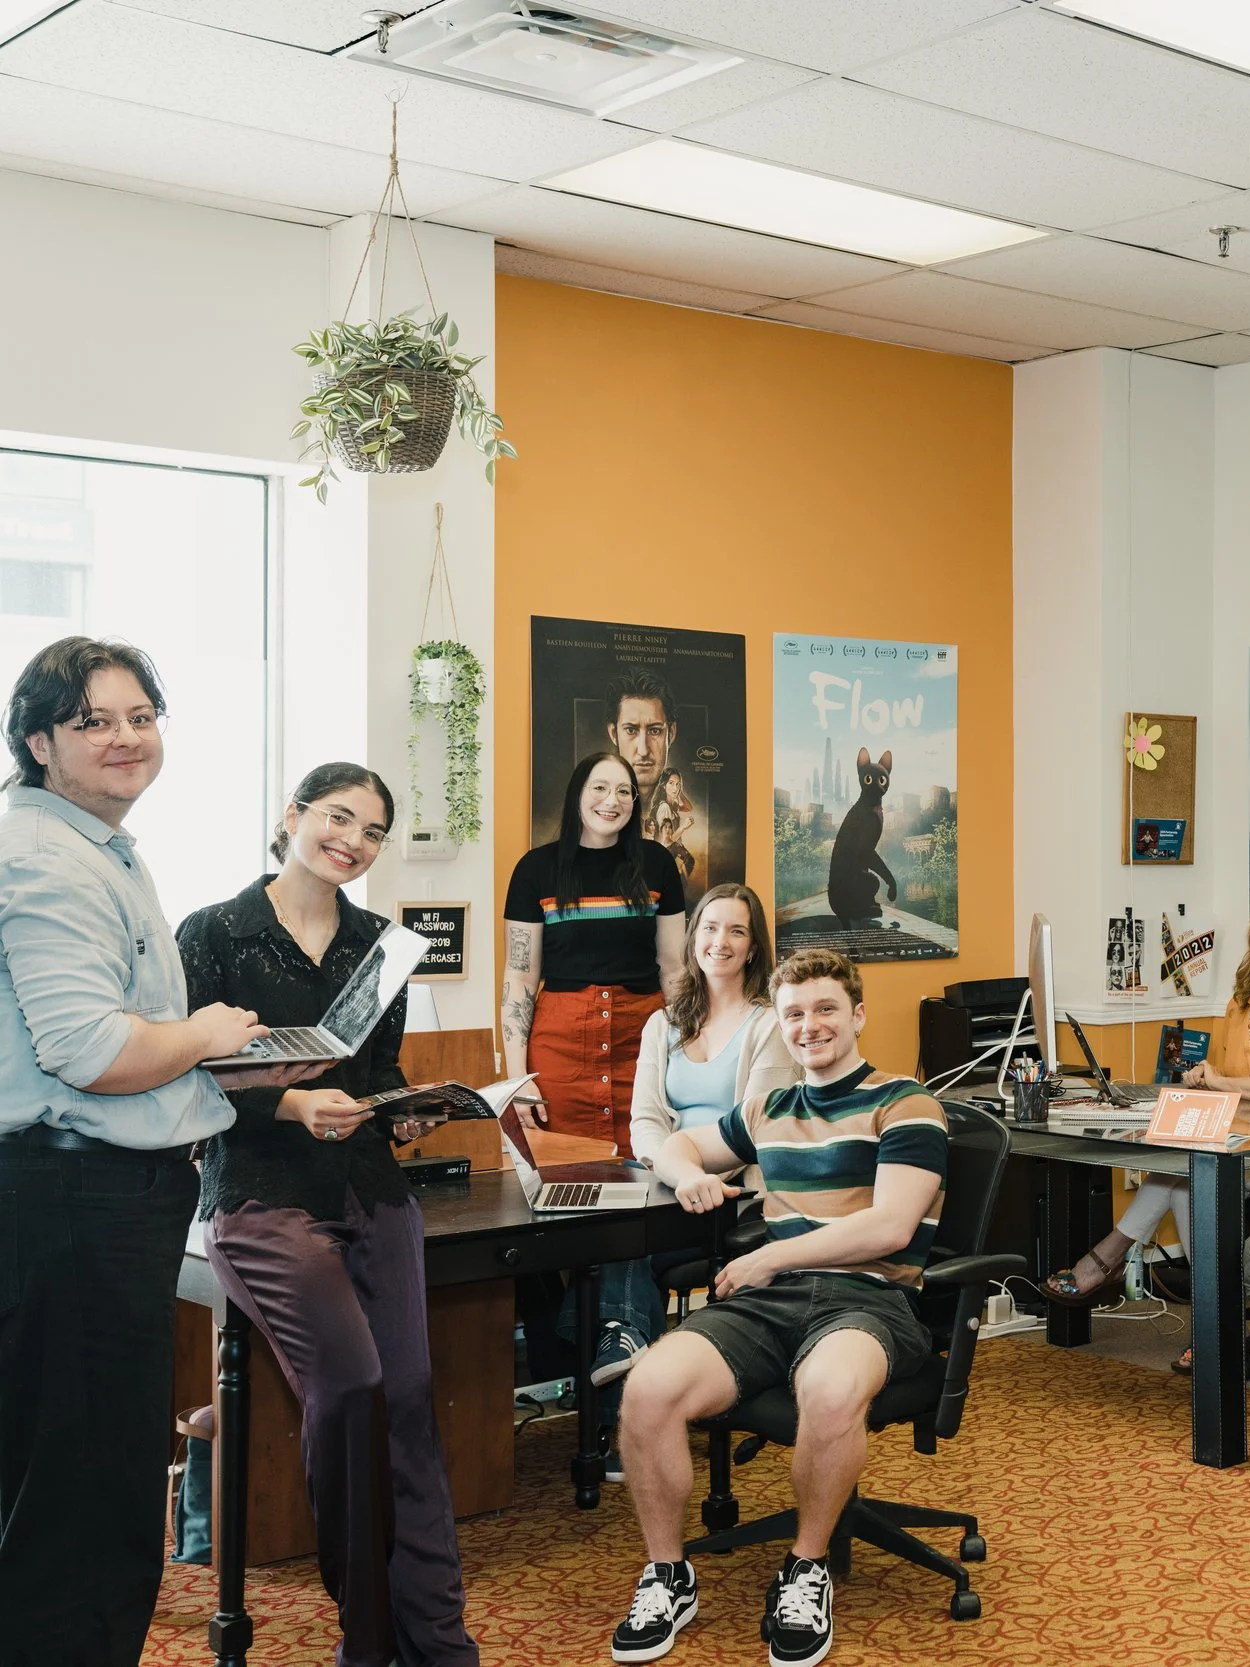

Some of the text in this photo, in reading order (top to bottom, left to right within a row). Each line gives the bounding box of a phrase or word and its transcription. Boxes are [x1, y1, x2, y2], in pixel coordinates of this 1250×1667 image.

[546, 639, 574, 647] BASTIEN
[614, 633, 668, 644] PIERRE NINEY
[809, 671, 924, 735] Flow
[413, 922, 455, 931] PASSWORD
[1173, 936, 1212, 966] 2022
[1187, 958, 1207, 971] ANNUAL
[1190, 964, 1209, 978] REPORT
